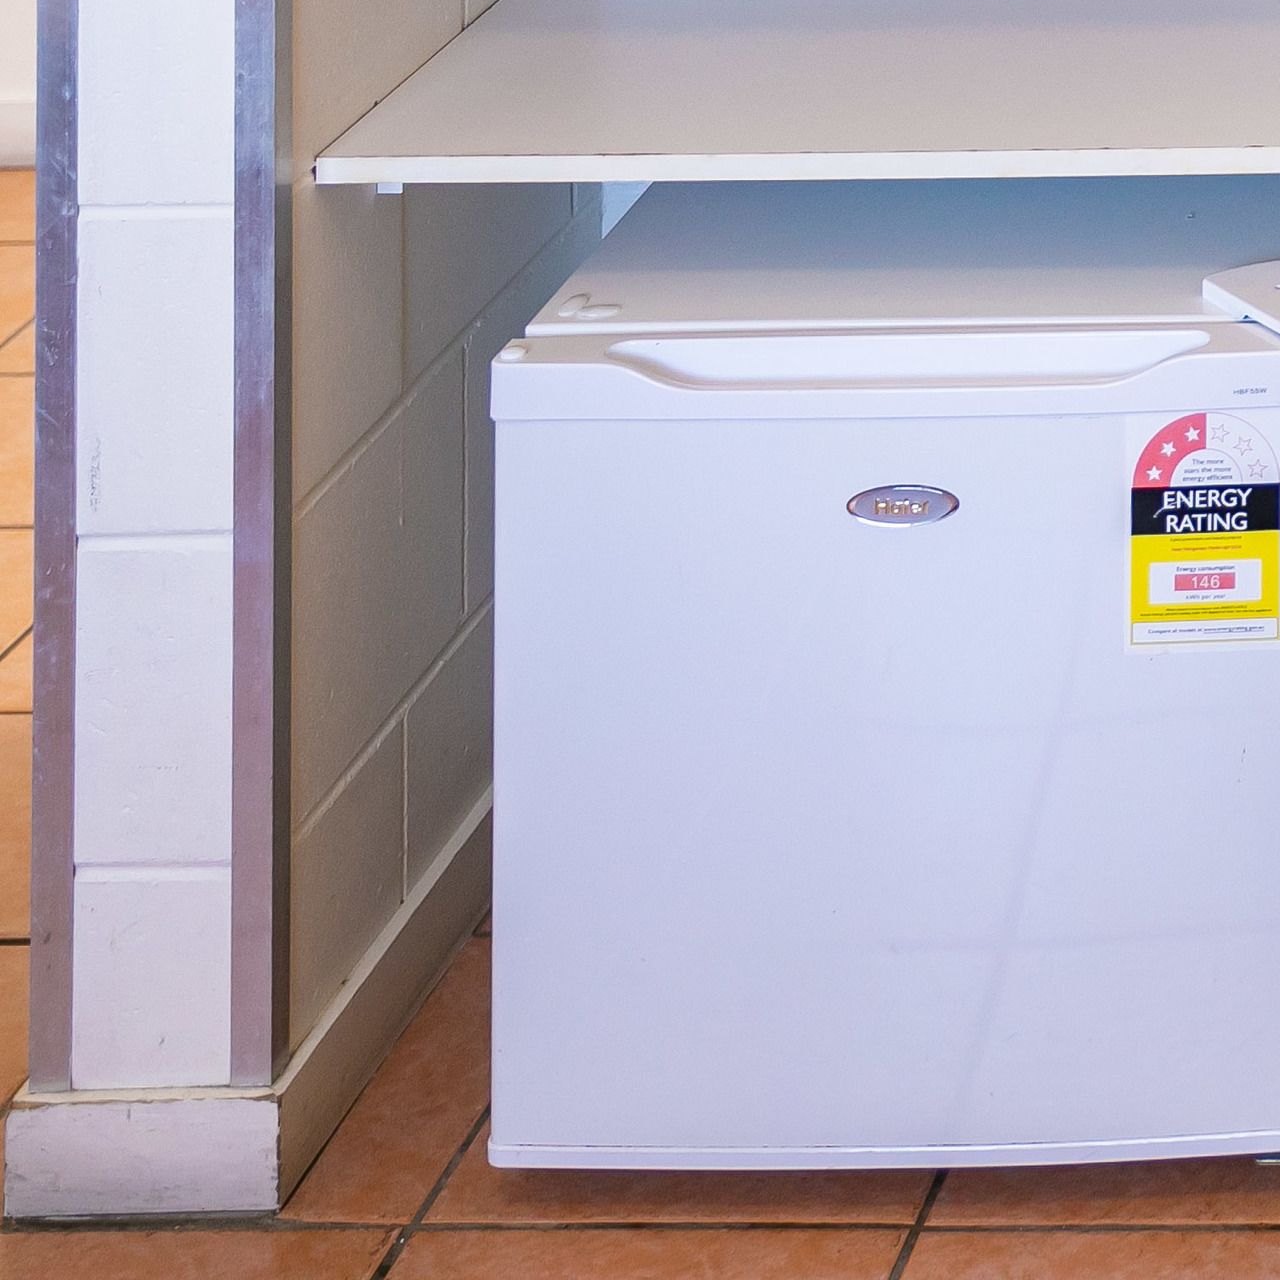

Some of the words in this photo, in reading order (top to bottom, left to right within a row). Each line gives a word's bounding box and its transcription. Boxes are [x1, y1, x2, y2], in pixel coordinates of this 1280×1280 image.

[1163, 488, 1252, 509] ENERGY
[1166, 512, 1248, 532] RATING
[1191, 575, 1220, 588] 146
